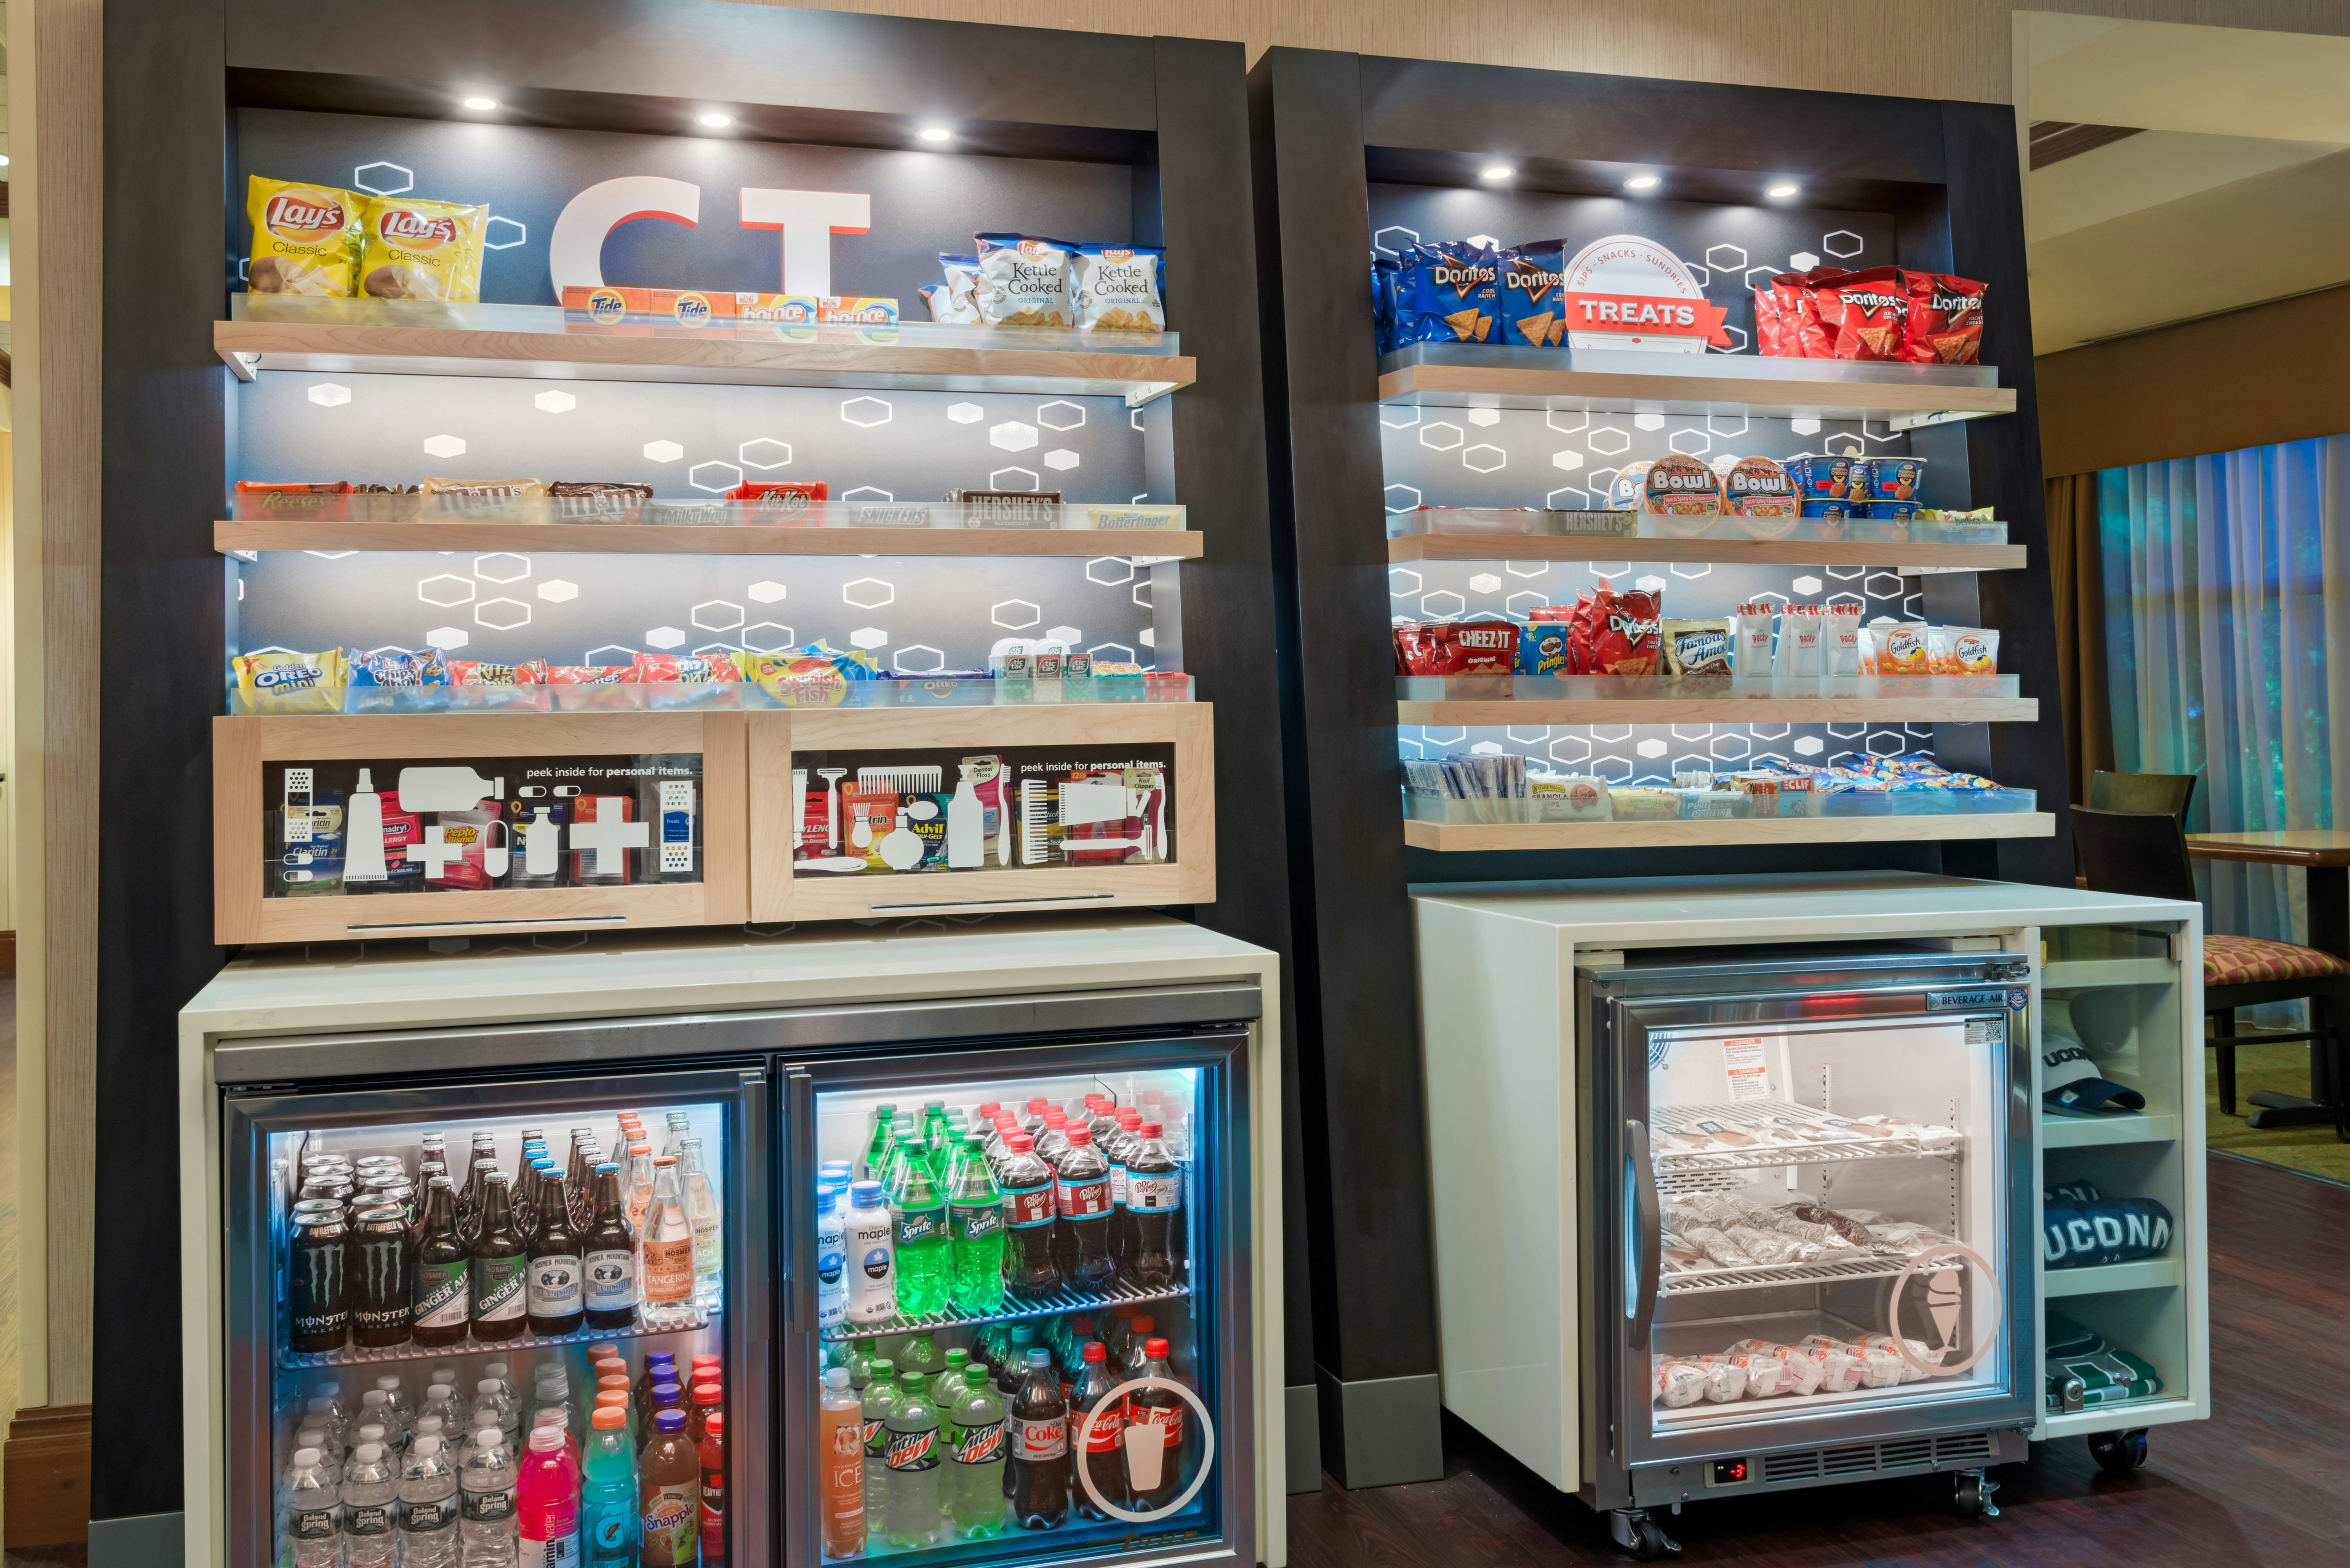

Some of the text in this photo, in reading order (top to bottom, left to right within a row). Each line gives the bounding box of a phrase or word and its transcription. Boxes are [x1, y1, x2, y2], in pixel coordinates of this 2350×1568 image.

[270, 198, 341, 230] Lay's
[384, 212, 453, 239] Lay's
[273, 241, 327, 257] Classic
[389, 249, 441, 267] Classic
[1012, 262, 1056, 279] Kettle
[1098, 266, 1141, 280] Kettle
[1436, 267, 1496, 284] Doritos
[1578, 250, 1688, 294] SIPS SNACKS SUNDRIES
[1008, 278, 1063, 294] Cooked
[1094, 279, 1148, 296] Cooked
[591, 297, 622, 319] Tide
[1839, 294, 1896, 307] Doritos
[677, 301, 708, 322] Tide
[742, 305, 806, 328] bounce
[1579, 299, 1695, 326] TREATS
[825, 309, 888, 332] bounce
[1670, 458, 1703, 468] Maruchan
[1748, 460, 1779, 470] Maruchan
[1654, 470, 1712, 489] Bowl
[1733, 472, 1787, 492] Bowl
[262, 490, 327, 510] Reese's
[861, 507, 927, 524] SNICKERS
[972, 495, 1053, 521] HERSHEY'S
[1098, 514, 1170, 529] Butterfinger
[1566, 512, 1623, 531] HERSHEY'S
[1675, 632, 1726, 657] Famous
[1891, 637, 1921, 654] Goldfish
[1959, 644, 1988, 658] Goldfish
[1688, 644, 1726, 666] Amos
[1538, 655, 1565, 675] Pringles
[1688, 666, 1710, 675] Chocolate
[256, 668, 322, 685] OREO
[374, 667, 415, 683] Chips
[274, 678, 315, 694] mini
[777, 673, 841, 695] Swedish
[923, 681, 958, 690] OREO
[793, 687, 830, 704] Fish
[527, 766, 693, 779] peek inside for personal items.
[1021, 760, 1166, 773] peek inside for personal items.
[1788, 780, 1810, 789] CLIF
[444, 827, 479, 837] Pepto-
[911, 823, 943, 833] Advil
[448, 835, 477, 844] Bismol
[293, 847, 328, 857] Claritin
[1942, 994, 2003, 1005] BEVERAGE-AIR
[1080, 1186, 1101, 1201] Dr Pepper
[1136, 1183, 1155, 1194] Pepper
[1024, 1194, 1044, 1209] Dr Pepper
[309, 1226, 338, 1235] BATTLEFIELD
[367, 1222, 396, 1231] BATTLEFIELD
[696, 1224, 719, 1234] HOSMER
[903, 1221, 931, 1240] Sprite
[970, 1215, 997, 1235] Sprite
[2044, 1213, 2173, 1262] UCONN
[588, 1253, 629, 1263] HOSMER MOUNTAIN
[665, 1247, 691, 1257] HOSMER
[485, 1265, 514, 1274] HOSMER
[534, 1258, 577, 1268] HOSMER MOUNTAIN
[420, 1270, 447, 1279] HOSMER
[647, 1272, 691, 1285] TANGERINE
[427, 1280, 453, 1298] PALE DRY
[493, 1273, 518, 1292] PALE DRY
[612, 1280, 631, 1290] SODA
[415, 1269, 469, 1316] GINGER ALE
[479, 1281, 518, 1312] GINGER
[559, 1285, 577, 1296] SODA
[355, 1307, 410, 1322] MONSTER
[304, 1323, 346, 1334] ENERGY
[361, 1320, 404, 1329] ENERGY
[1025, 1425, 1062, 1441] Coke
[834, 1461, 861, 1469] SPARKLING
[834, 1466, 862, 1487] ICE
[480, 1500, 507, 1514] Spring
[482, 1495, 505, 1504] Poland
[358, 1510, 382, 1518] Poland
[411, 1512, 439, 1525] Spring
[646, 1504, 694, 1530] Snapple
[301, 1519, 329, 1532] Spring
[356, 1516, 384, 1528] Spring
[596, 1513, 625, 1549] G
